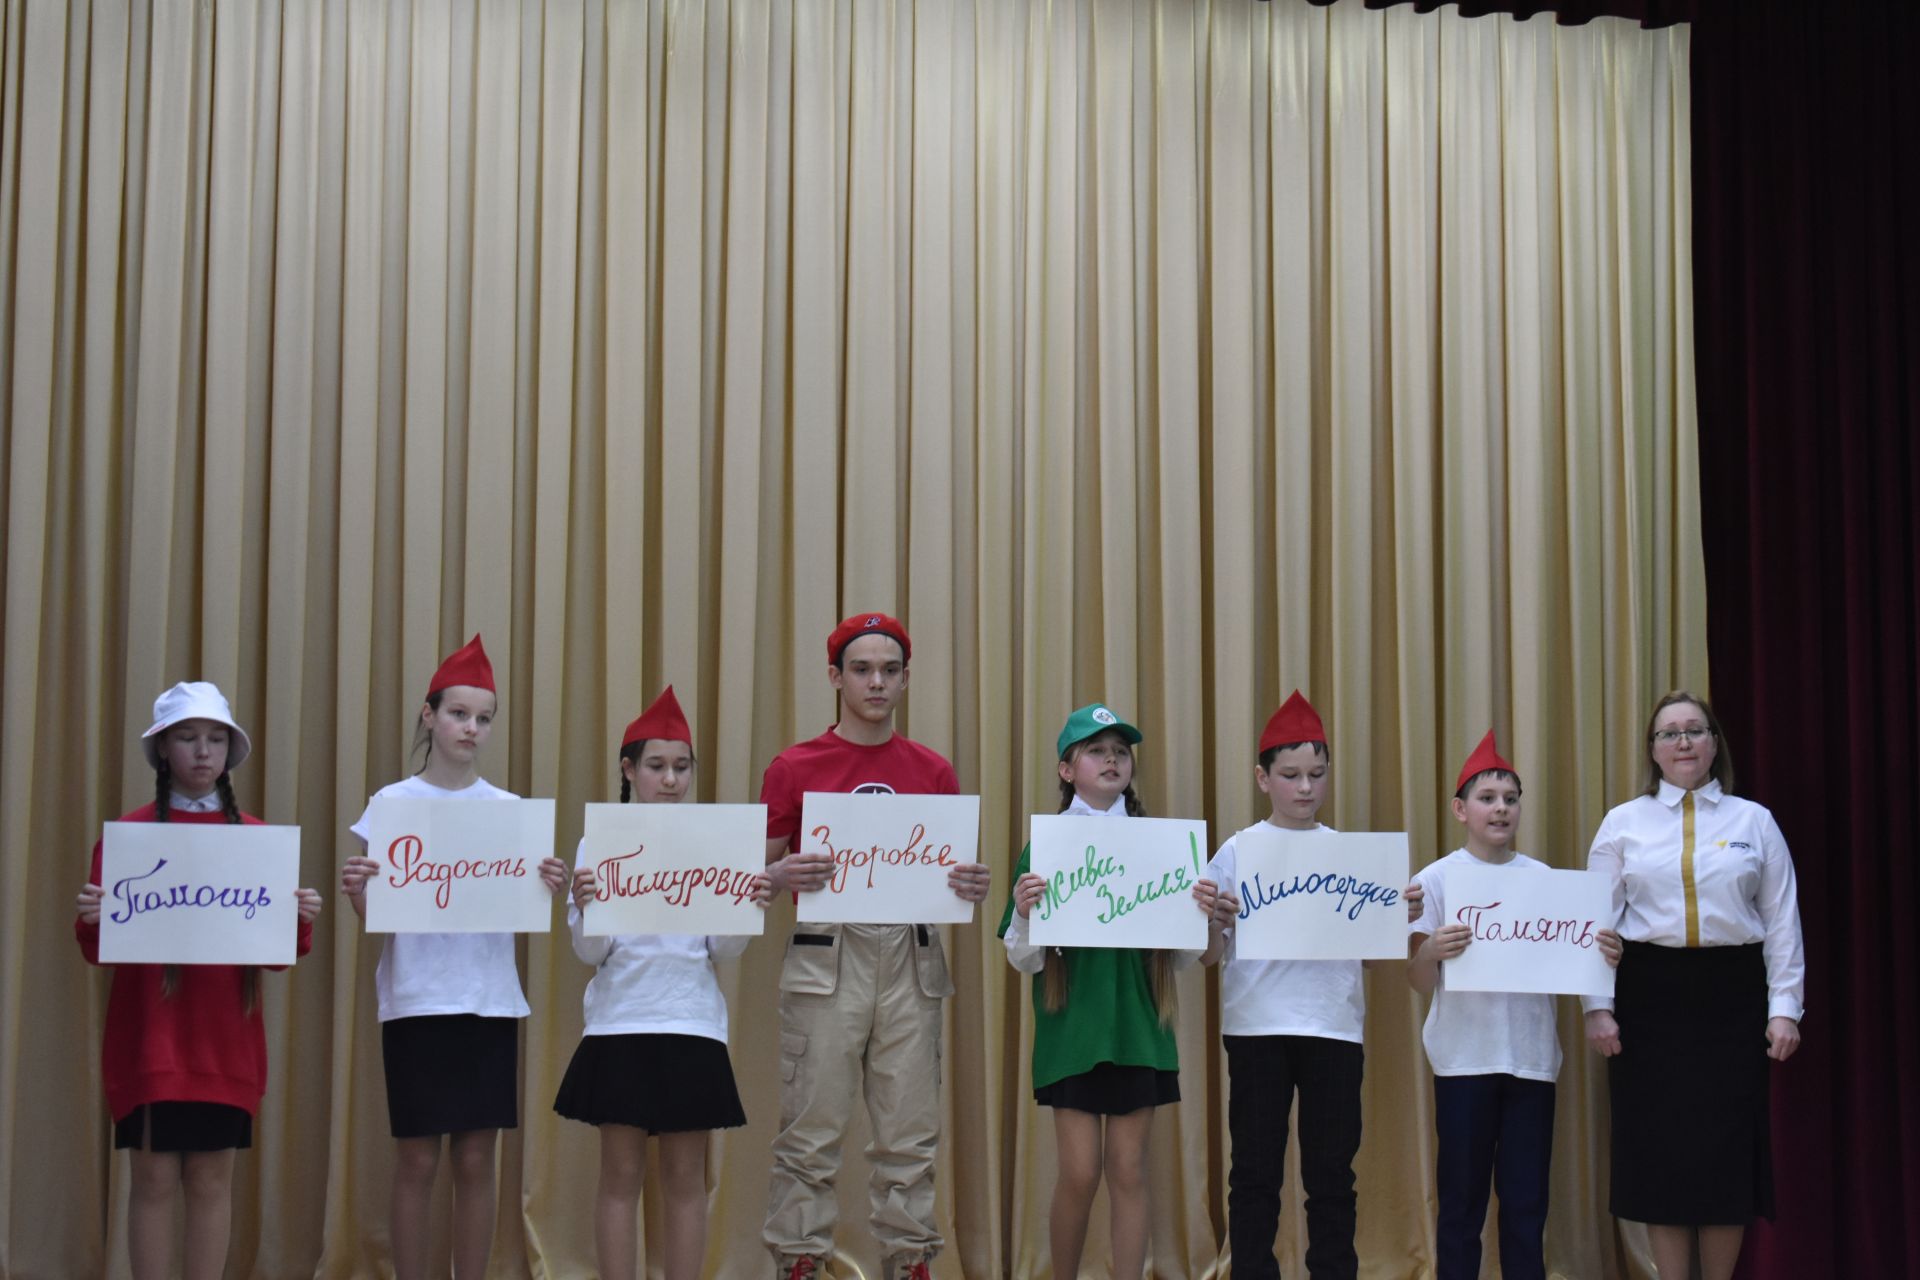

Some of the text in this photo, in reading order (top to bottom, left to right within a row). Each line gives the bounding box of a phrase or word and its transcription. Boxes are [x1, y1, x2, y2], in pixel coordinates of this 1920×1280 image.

[110, 857, 272, 924] Помощь
[388, 834, 527, 909] Радость
[811, 823, 958, 894] Здоровье
[1035, 845, 1125, 921] Живи,
[1237, 871, 1399, 921] Милосердие
[1456, 901, 1596, 949] Память
